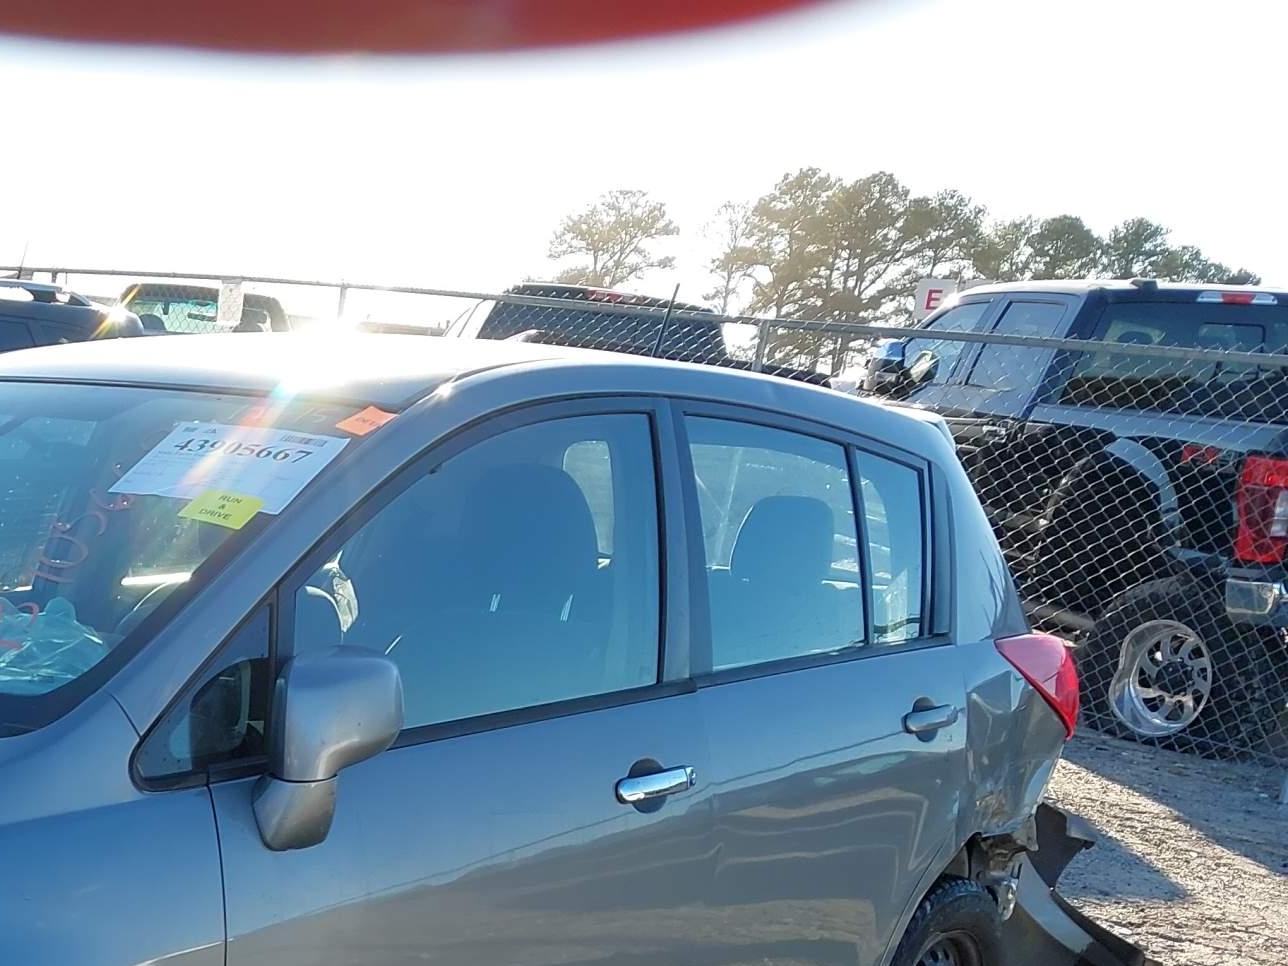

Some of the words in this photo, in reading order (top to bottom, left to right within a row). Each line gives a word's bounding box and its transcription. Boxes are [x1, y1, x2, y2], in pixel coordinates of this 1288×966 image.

[925, 289, 943, 310] E
[173, 437, 314, 464] 43905667
[218, 494, 243, 504] RUN
[198, 508, 233, 520] DRIVE
